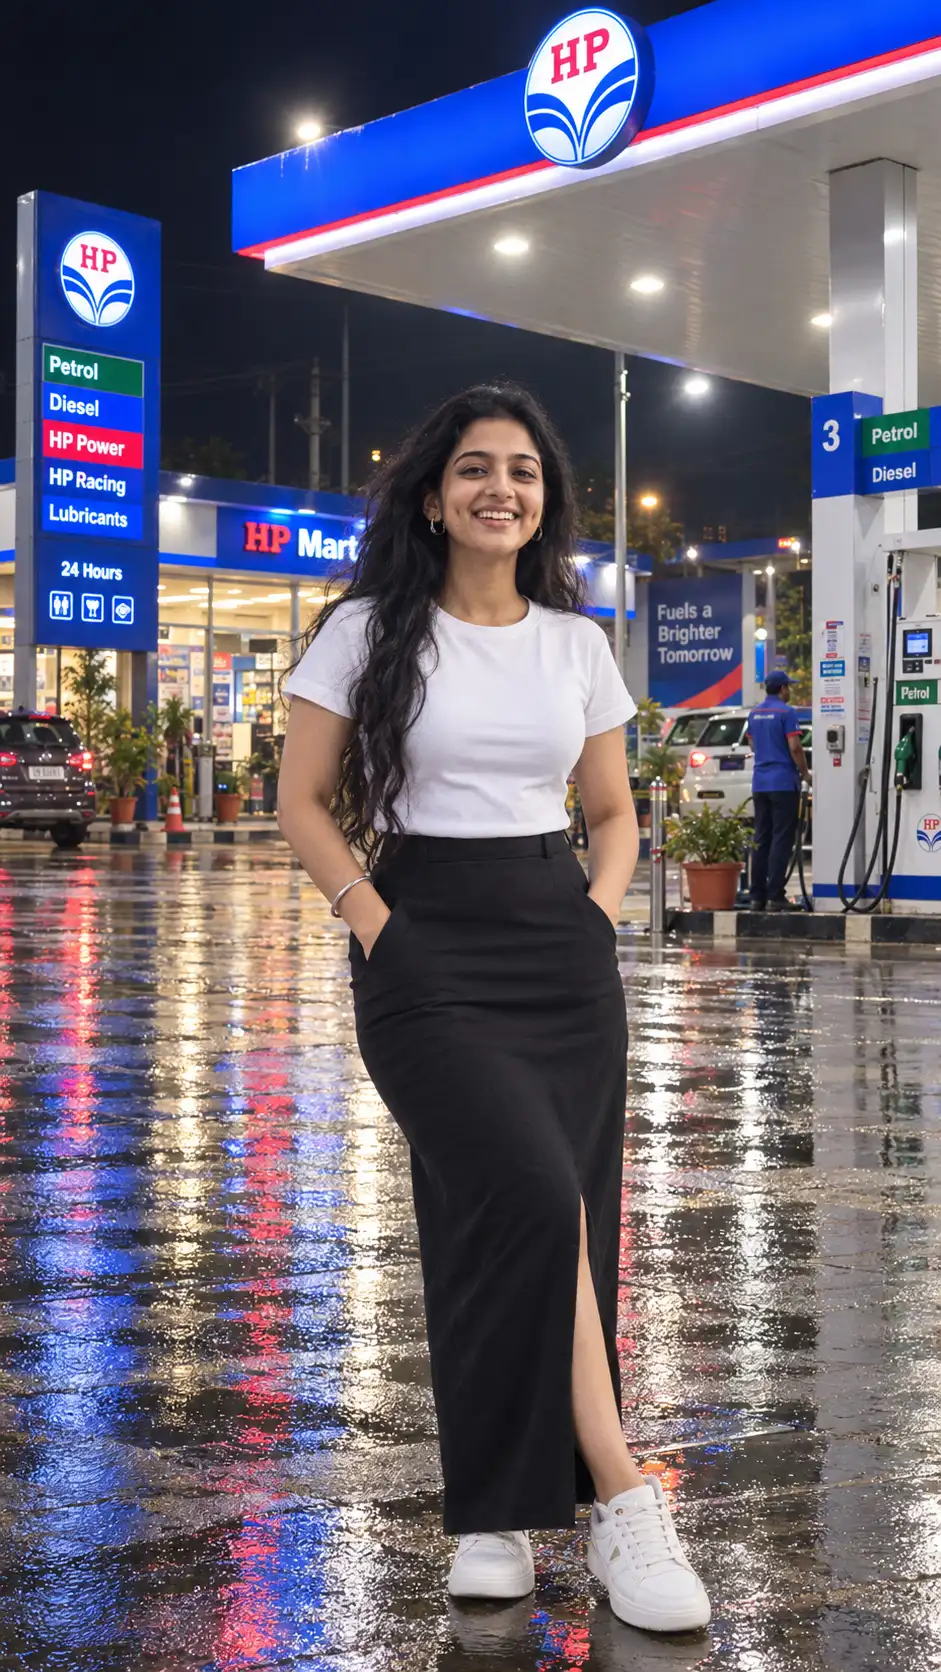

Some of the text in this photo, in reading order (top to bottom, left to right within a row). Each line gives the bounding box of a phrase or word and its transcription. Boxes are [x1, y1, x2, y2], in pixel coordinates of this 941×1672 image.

[551, 28, 610, 85] HP
[80, 244, 117, 273] HP
[49, 355, 99, 380] Petrol
[49, 392, 99, 417] Diesel
[49, 430, 125, 457] HP Power
[822, 419, 841, 452] 3
[871, 422, 918, 445] Petrol
[49, 467, 127, 497] HP Racing
[872, 461, 916, 483] Diesel
[49, 503, 128, 528] Lubricants
[245, 521, 359, 562] HP Mart
[61, 560, 123, 581] 24 Hours
[657, 602, 713, 621] Fuels a
[657, 624, 721, 645] Brighter
[657, 647, 733, 664] Tomorrow
[900, 686, 930, 700] Petrol
[924, 819, 940, 830] HP
